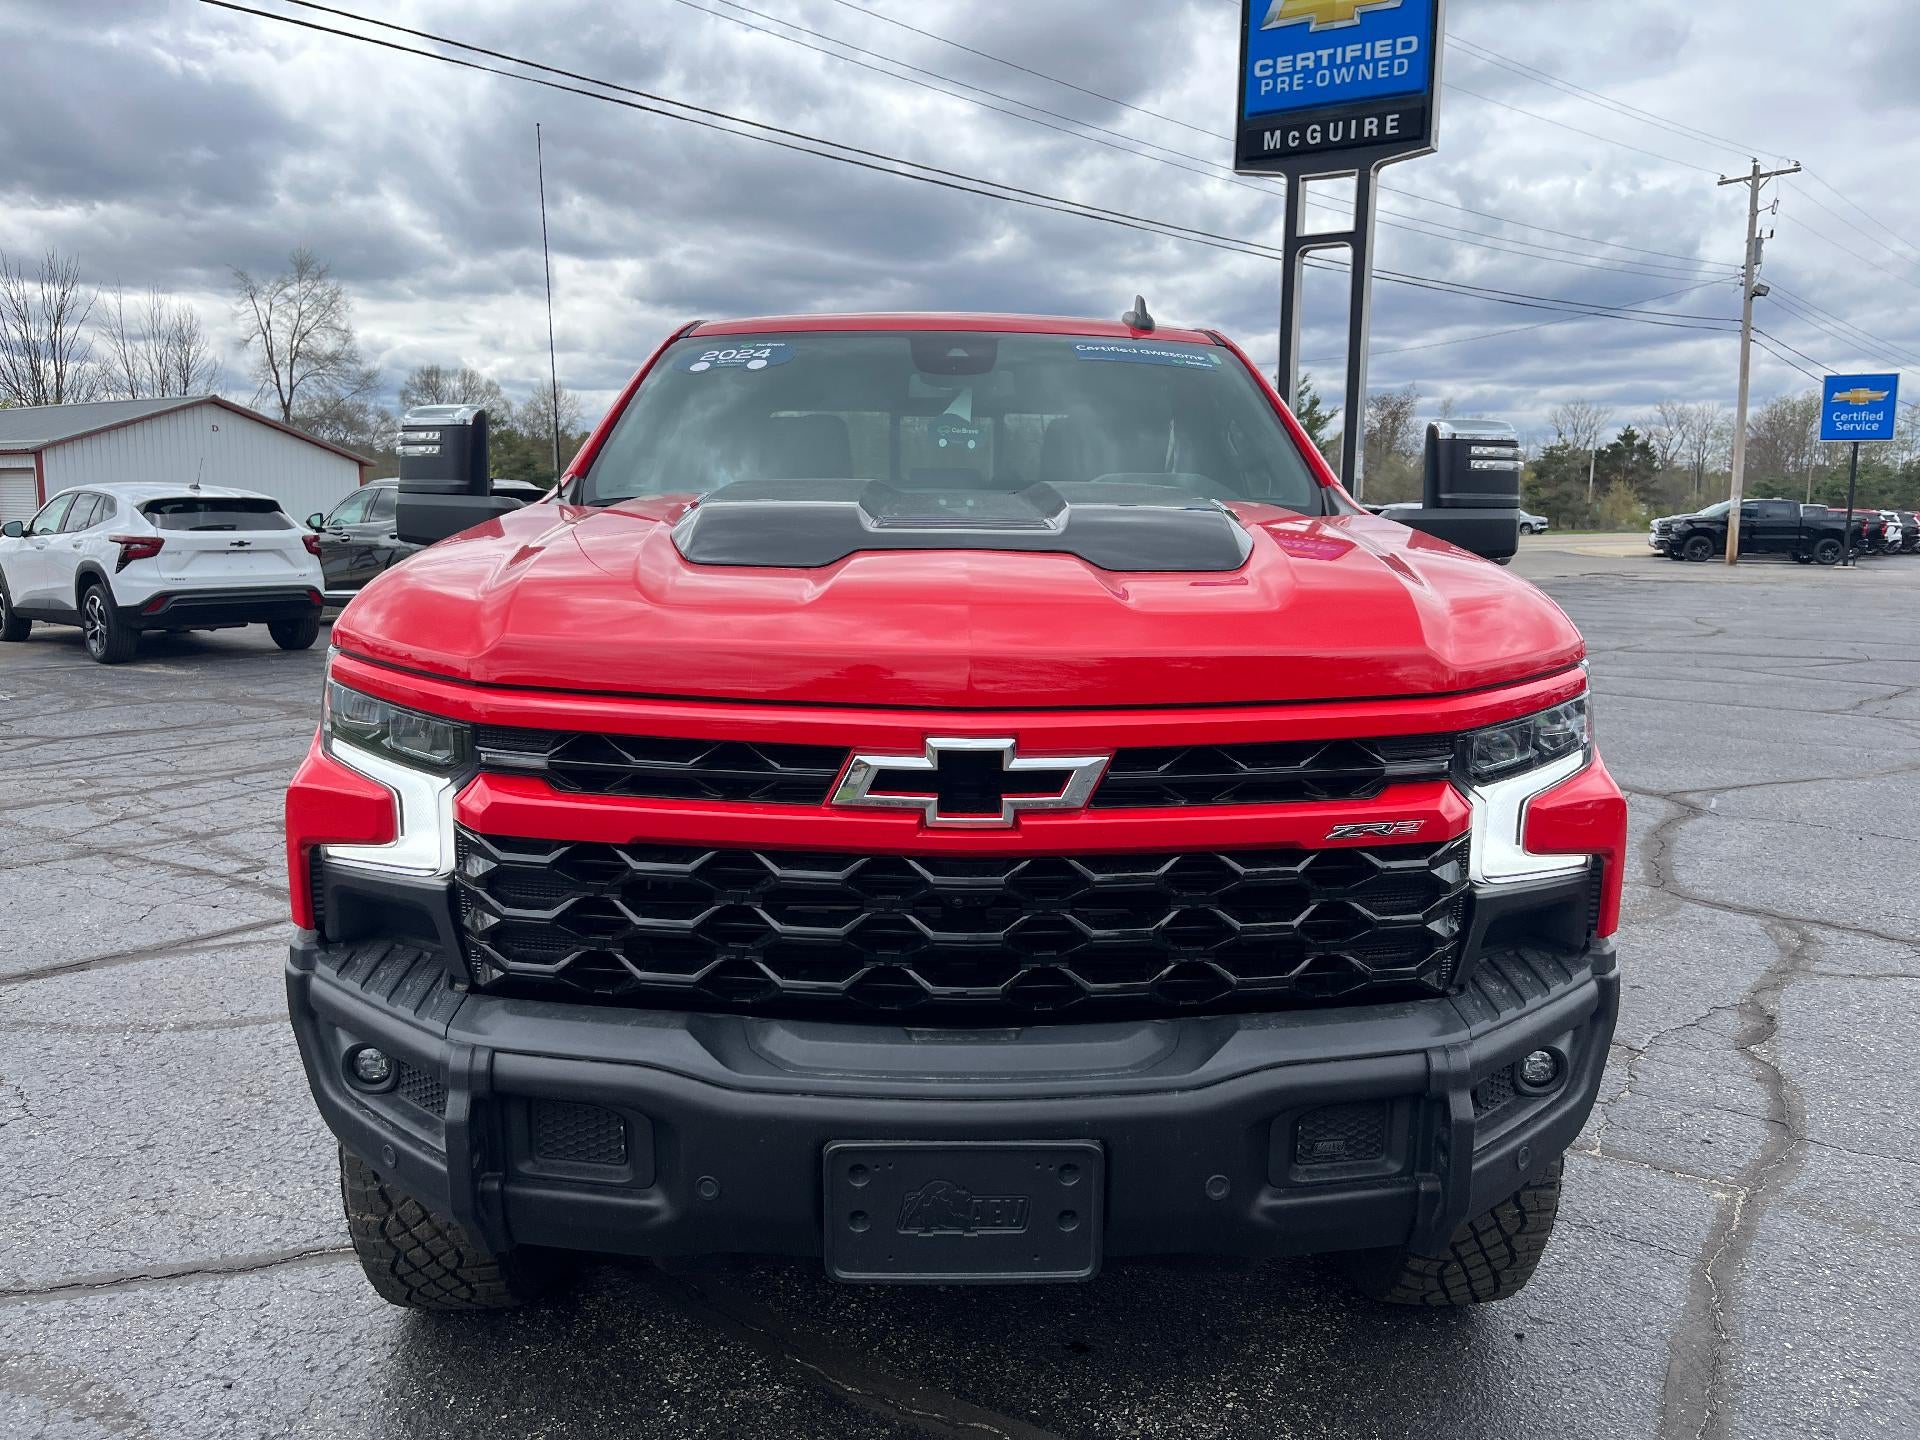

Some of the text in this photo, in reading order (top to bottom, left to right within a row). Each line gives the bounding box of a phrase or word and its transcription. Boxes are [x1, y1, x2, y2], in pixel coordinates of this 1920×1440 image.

[1254, 35, 1419, 77] CERTIFIED
[1260, 58, 1409, 95] PRE-OWNED
[1263, 114, 1400, 150] McGUIRE
[700, 348, 772, 361] 2024
[1075, 344, 1137, 354] Certified
[1832, 411, 1884, 421] Certified
[1836, 421, 1879, 431] Service
[1325, 819, 1425, 839] ZR2
